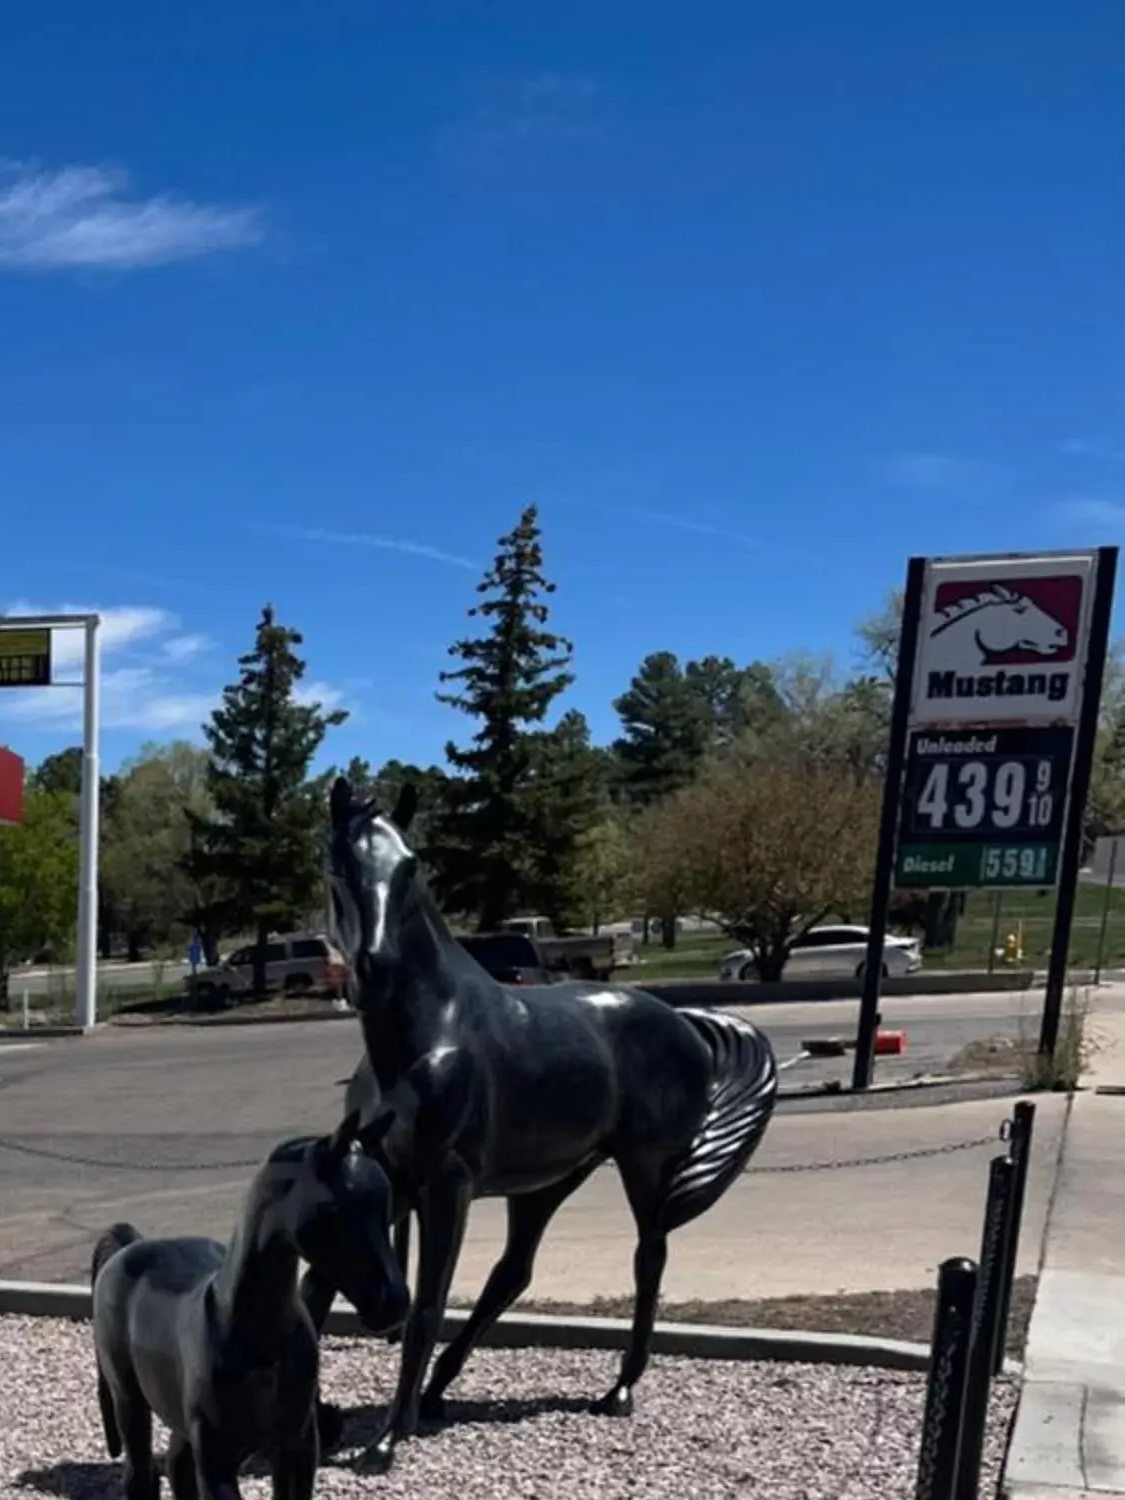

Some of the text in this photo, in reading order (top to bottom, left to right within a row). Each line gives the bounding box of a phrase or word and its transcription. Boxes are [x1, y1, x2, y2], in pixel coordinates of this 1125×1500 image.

[927, 669, 1070, 701] Mustang
[917, 735, 997, 755] Unleaded
[917, 761, 1026, 828] 439
[903, 853, 955, 873] Diesel
